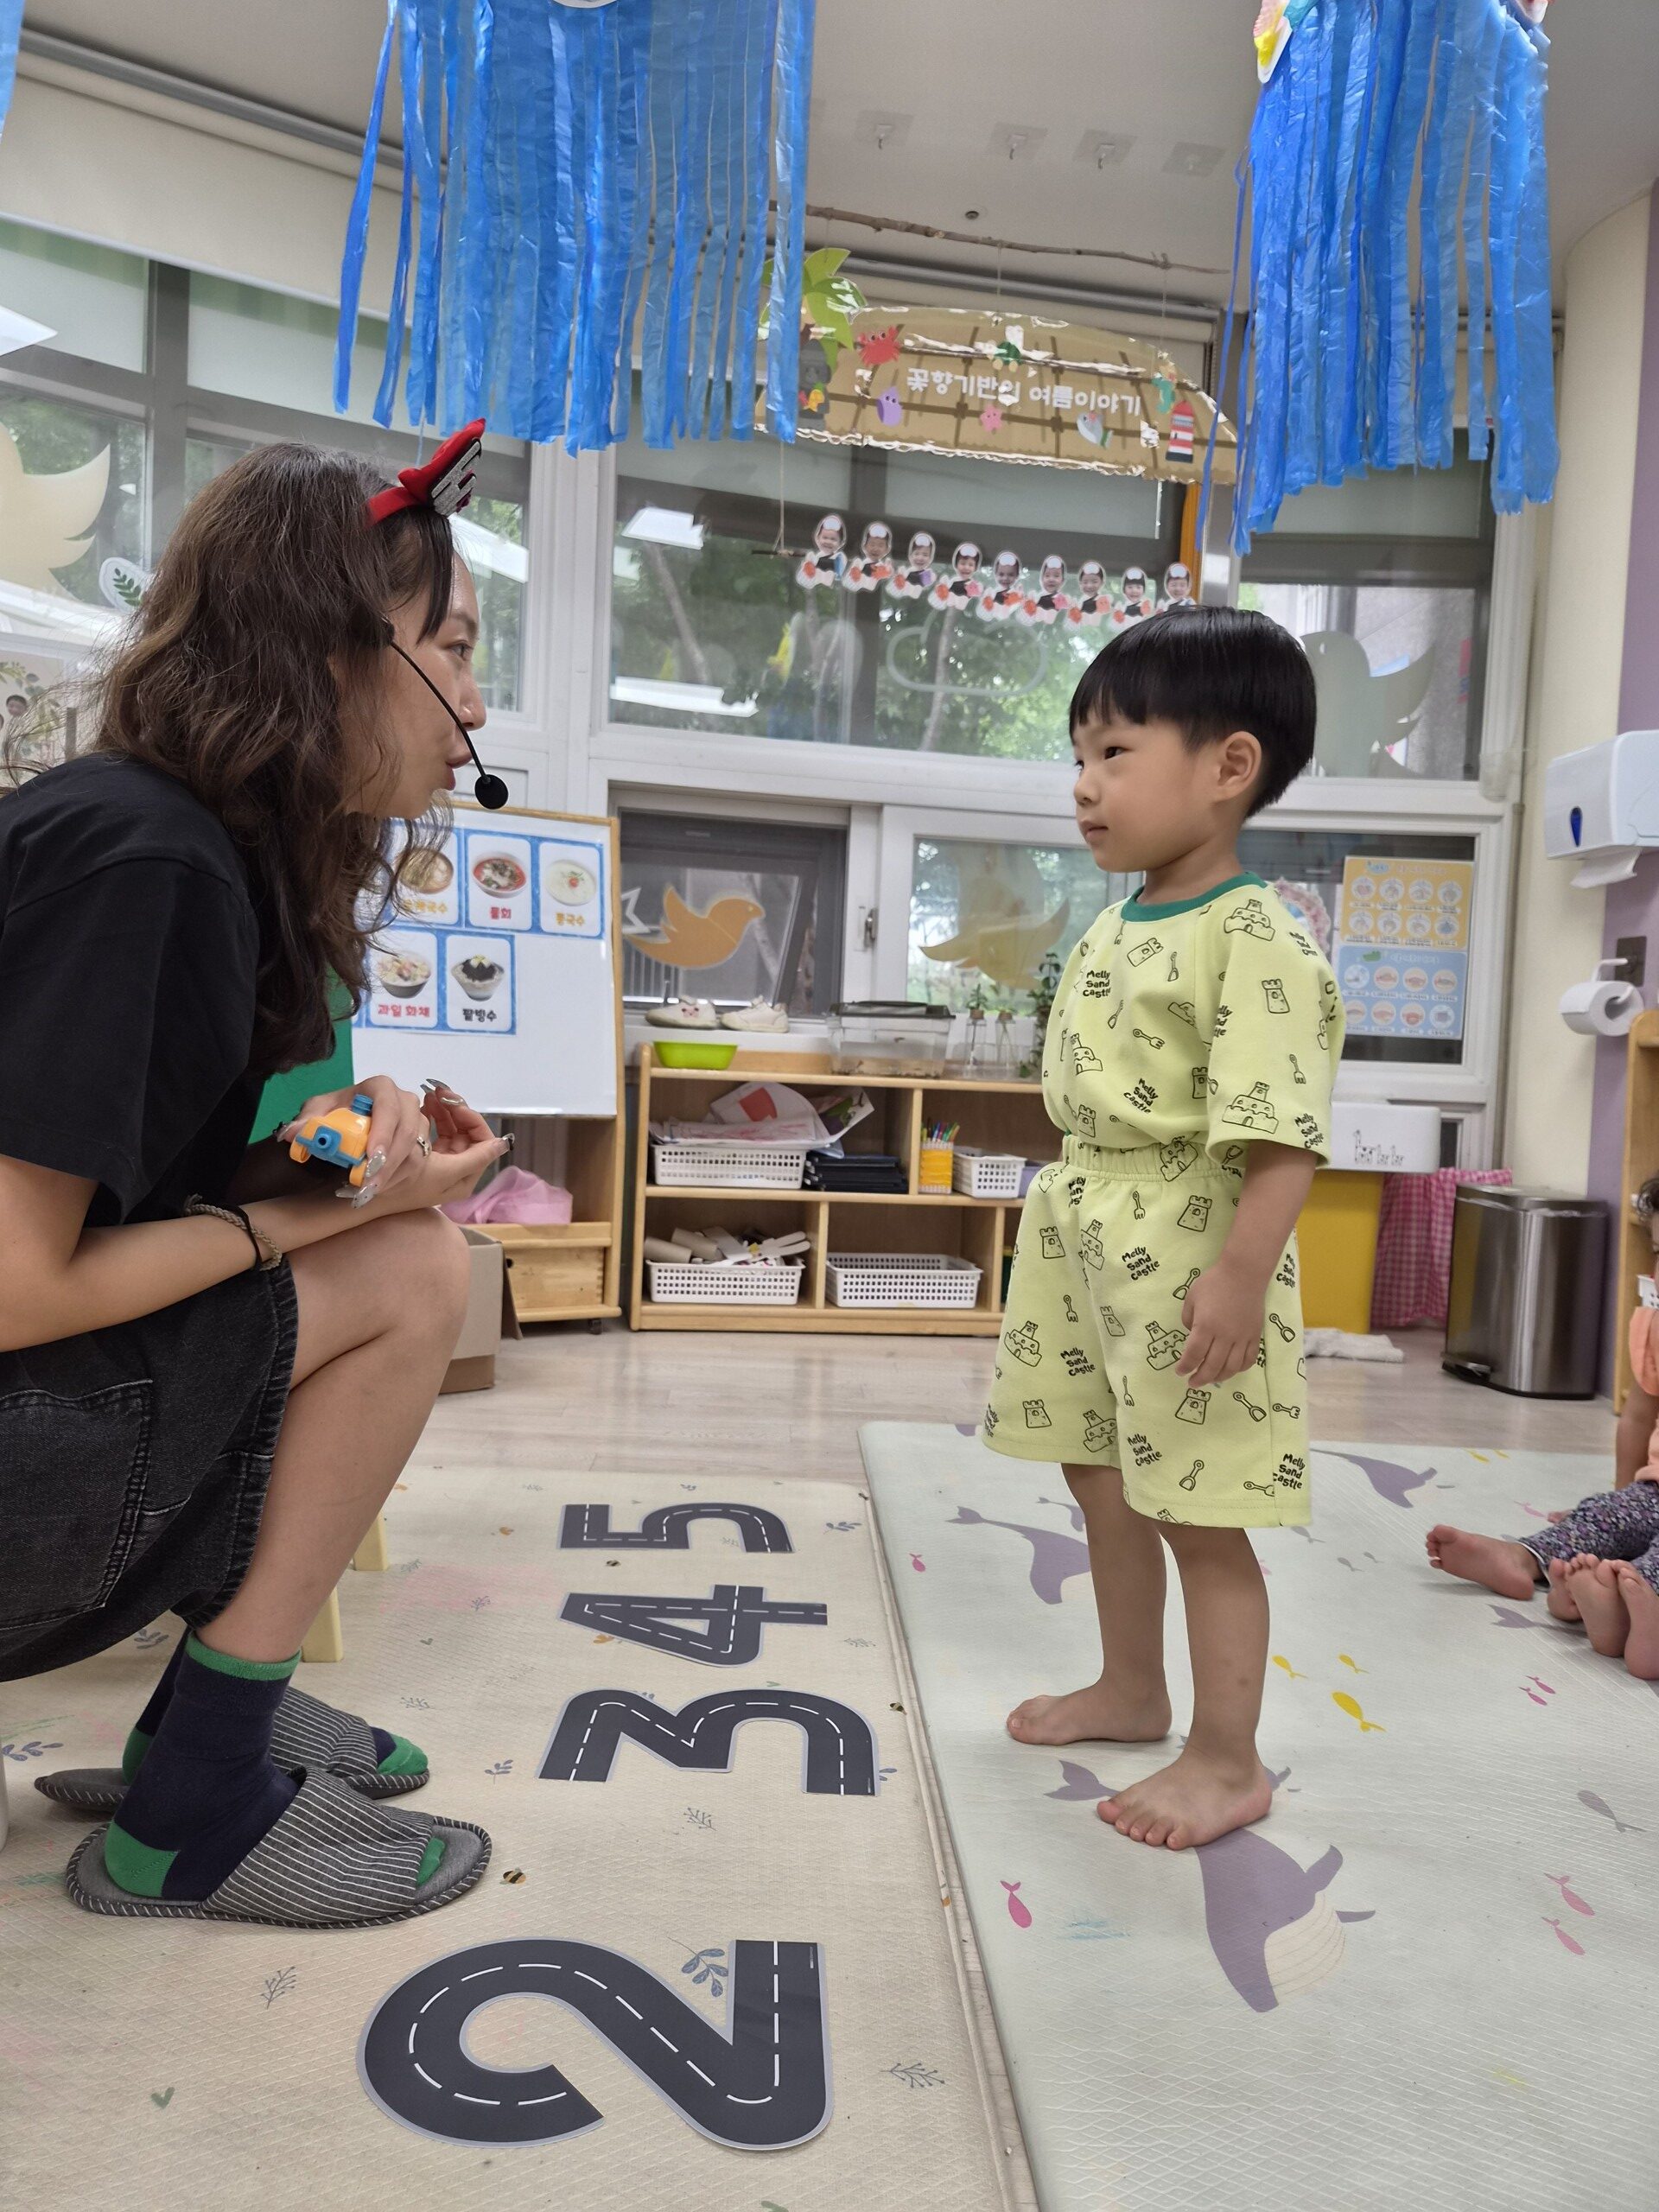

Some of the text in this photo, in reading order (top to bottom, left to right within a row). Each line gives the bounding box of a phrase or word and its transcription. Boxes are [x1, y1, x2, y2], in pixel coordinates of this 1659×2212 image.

[906, 367, 1141, 416] 꽃향기반의 여름이야기
[490, 906, 512, 919] 물회
[1085, 979, 1110, 988] Sand
[1086, 970, 1111, 981] Melly
[378, 1004, 430, 1017] 과일 화채
[462, 1007, 498, 1023] 팥빙수
[1133, 1086, 1154, 1106] Sand
[1138, 1077, 1159, 1099] Melly
[1294, 1113, 1314, 1127] Melly
[1122, 1246, 1147, 1262] Melly
[1126, 1253, 1152, 1271] Sand
[1059, 1347, 1084, 1359] Melly
[1065, 1356, 1089, 1367] Sand
[1132, 1442, 1154, 1456] Sand
[1282, 1453, 1306, 1471] Melly
[1278, 1464, 1303, 1479] Sand
[559, 1503, 793, 1554] 5
[556, 1585, 827, 1667] 4
[537, 1689, 880, 1796] 3
[358, 1938, 833, 2150] 2
